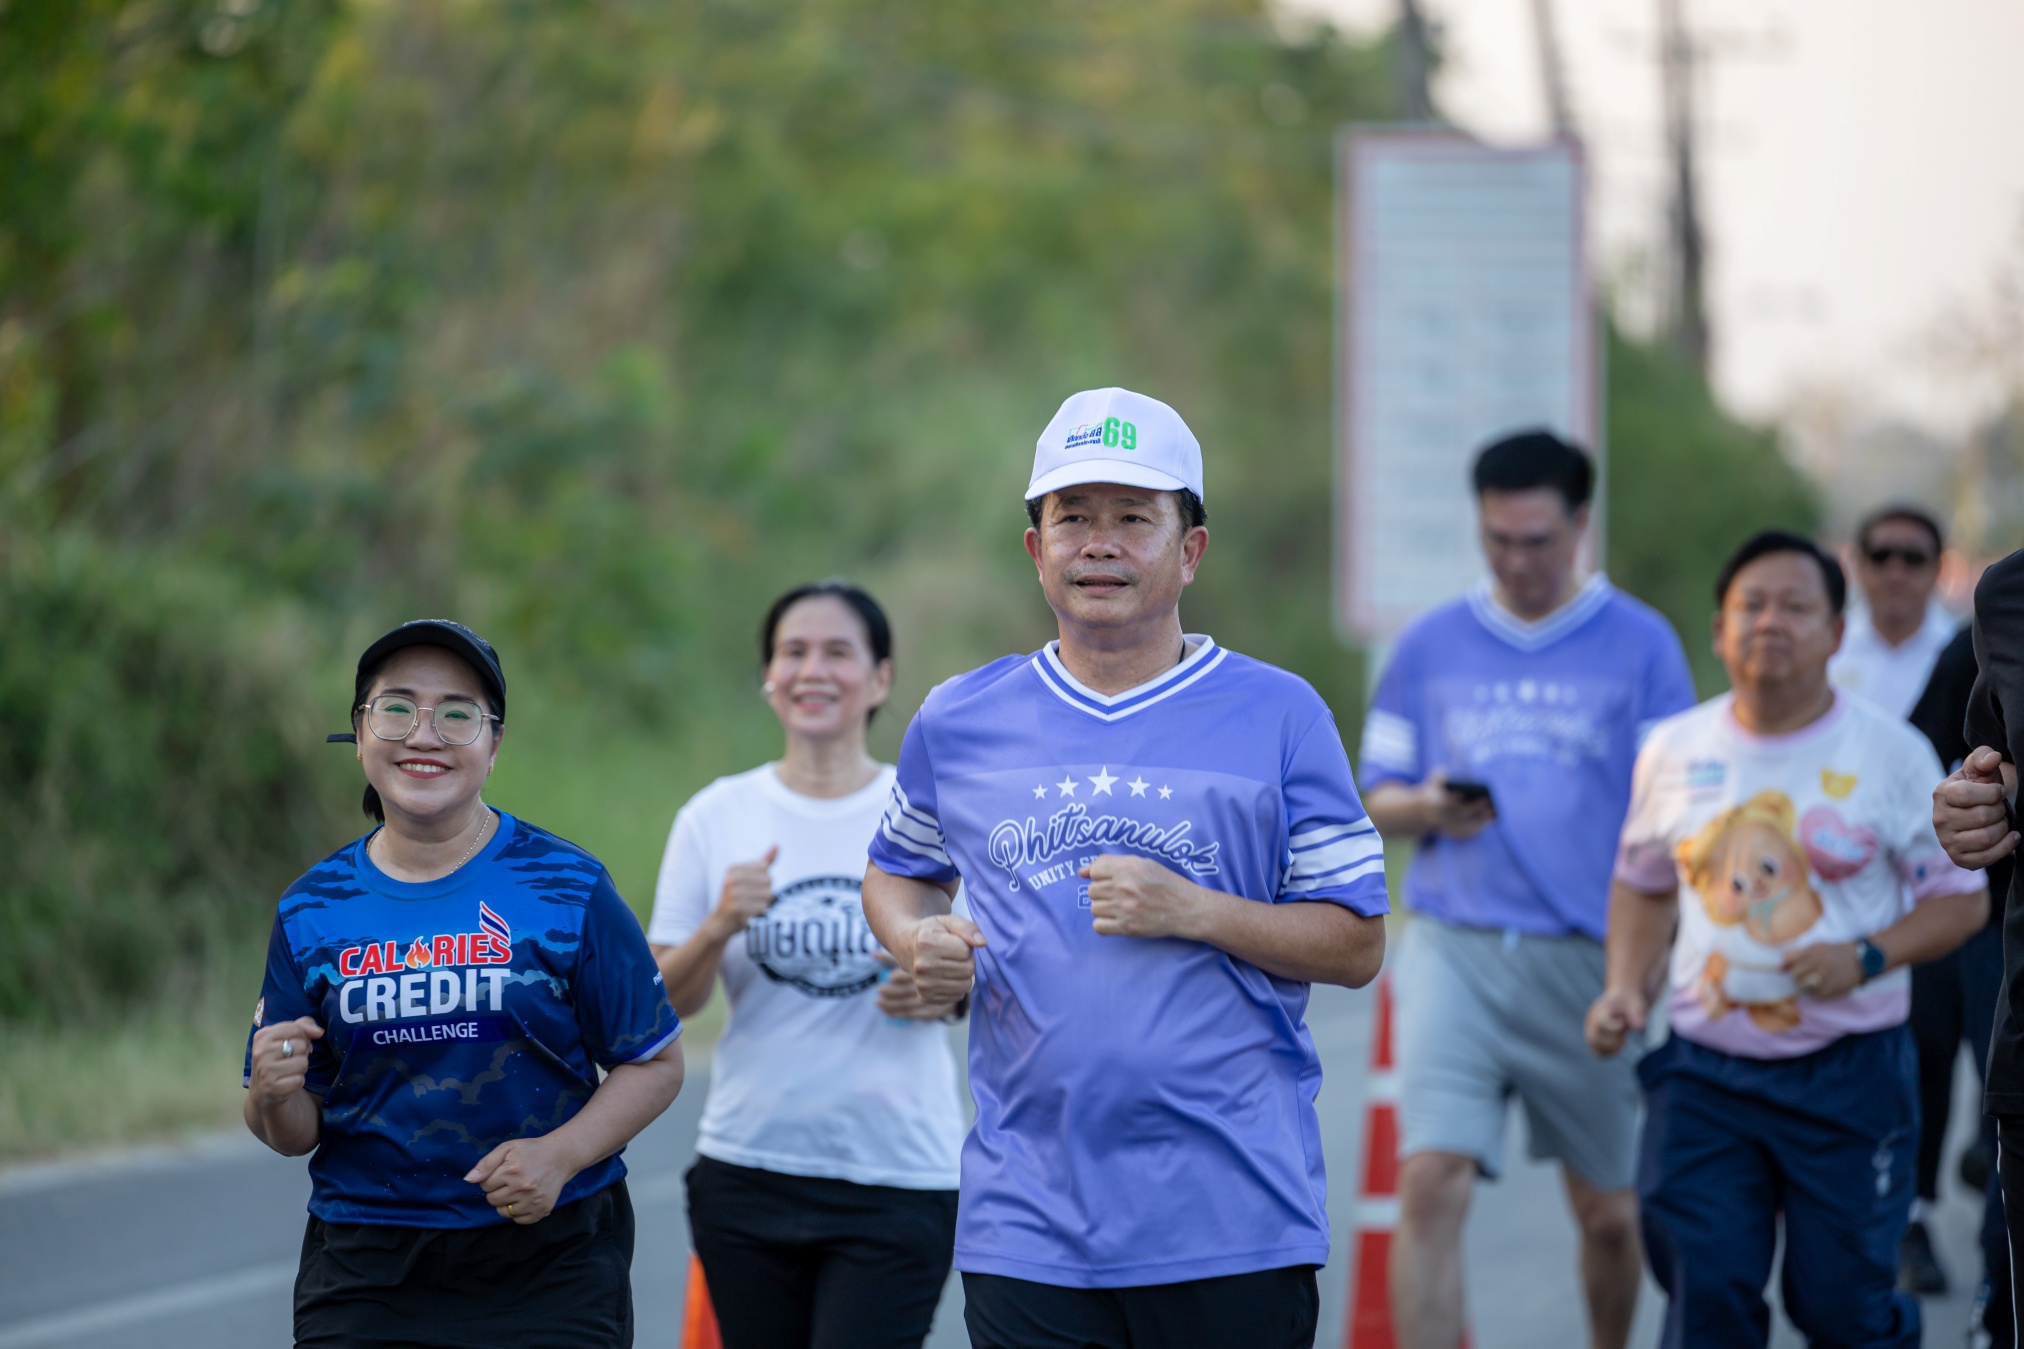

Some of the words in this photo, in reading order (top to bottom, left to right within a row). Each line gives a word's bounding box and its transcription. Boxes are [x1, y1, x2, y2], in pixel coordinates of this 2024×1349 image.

[1103, 416, 1137, 450] 69
[988, 802, 1220, 892] Phitsanulok
[1028, 860, 1075, 890] UNITY
[339, 968, 511, 1024] CREDIT
[373, 1022, 479, 1046] CHALLENGE
